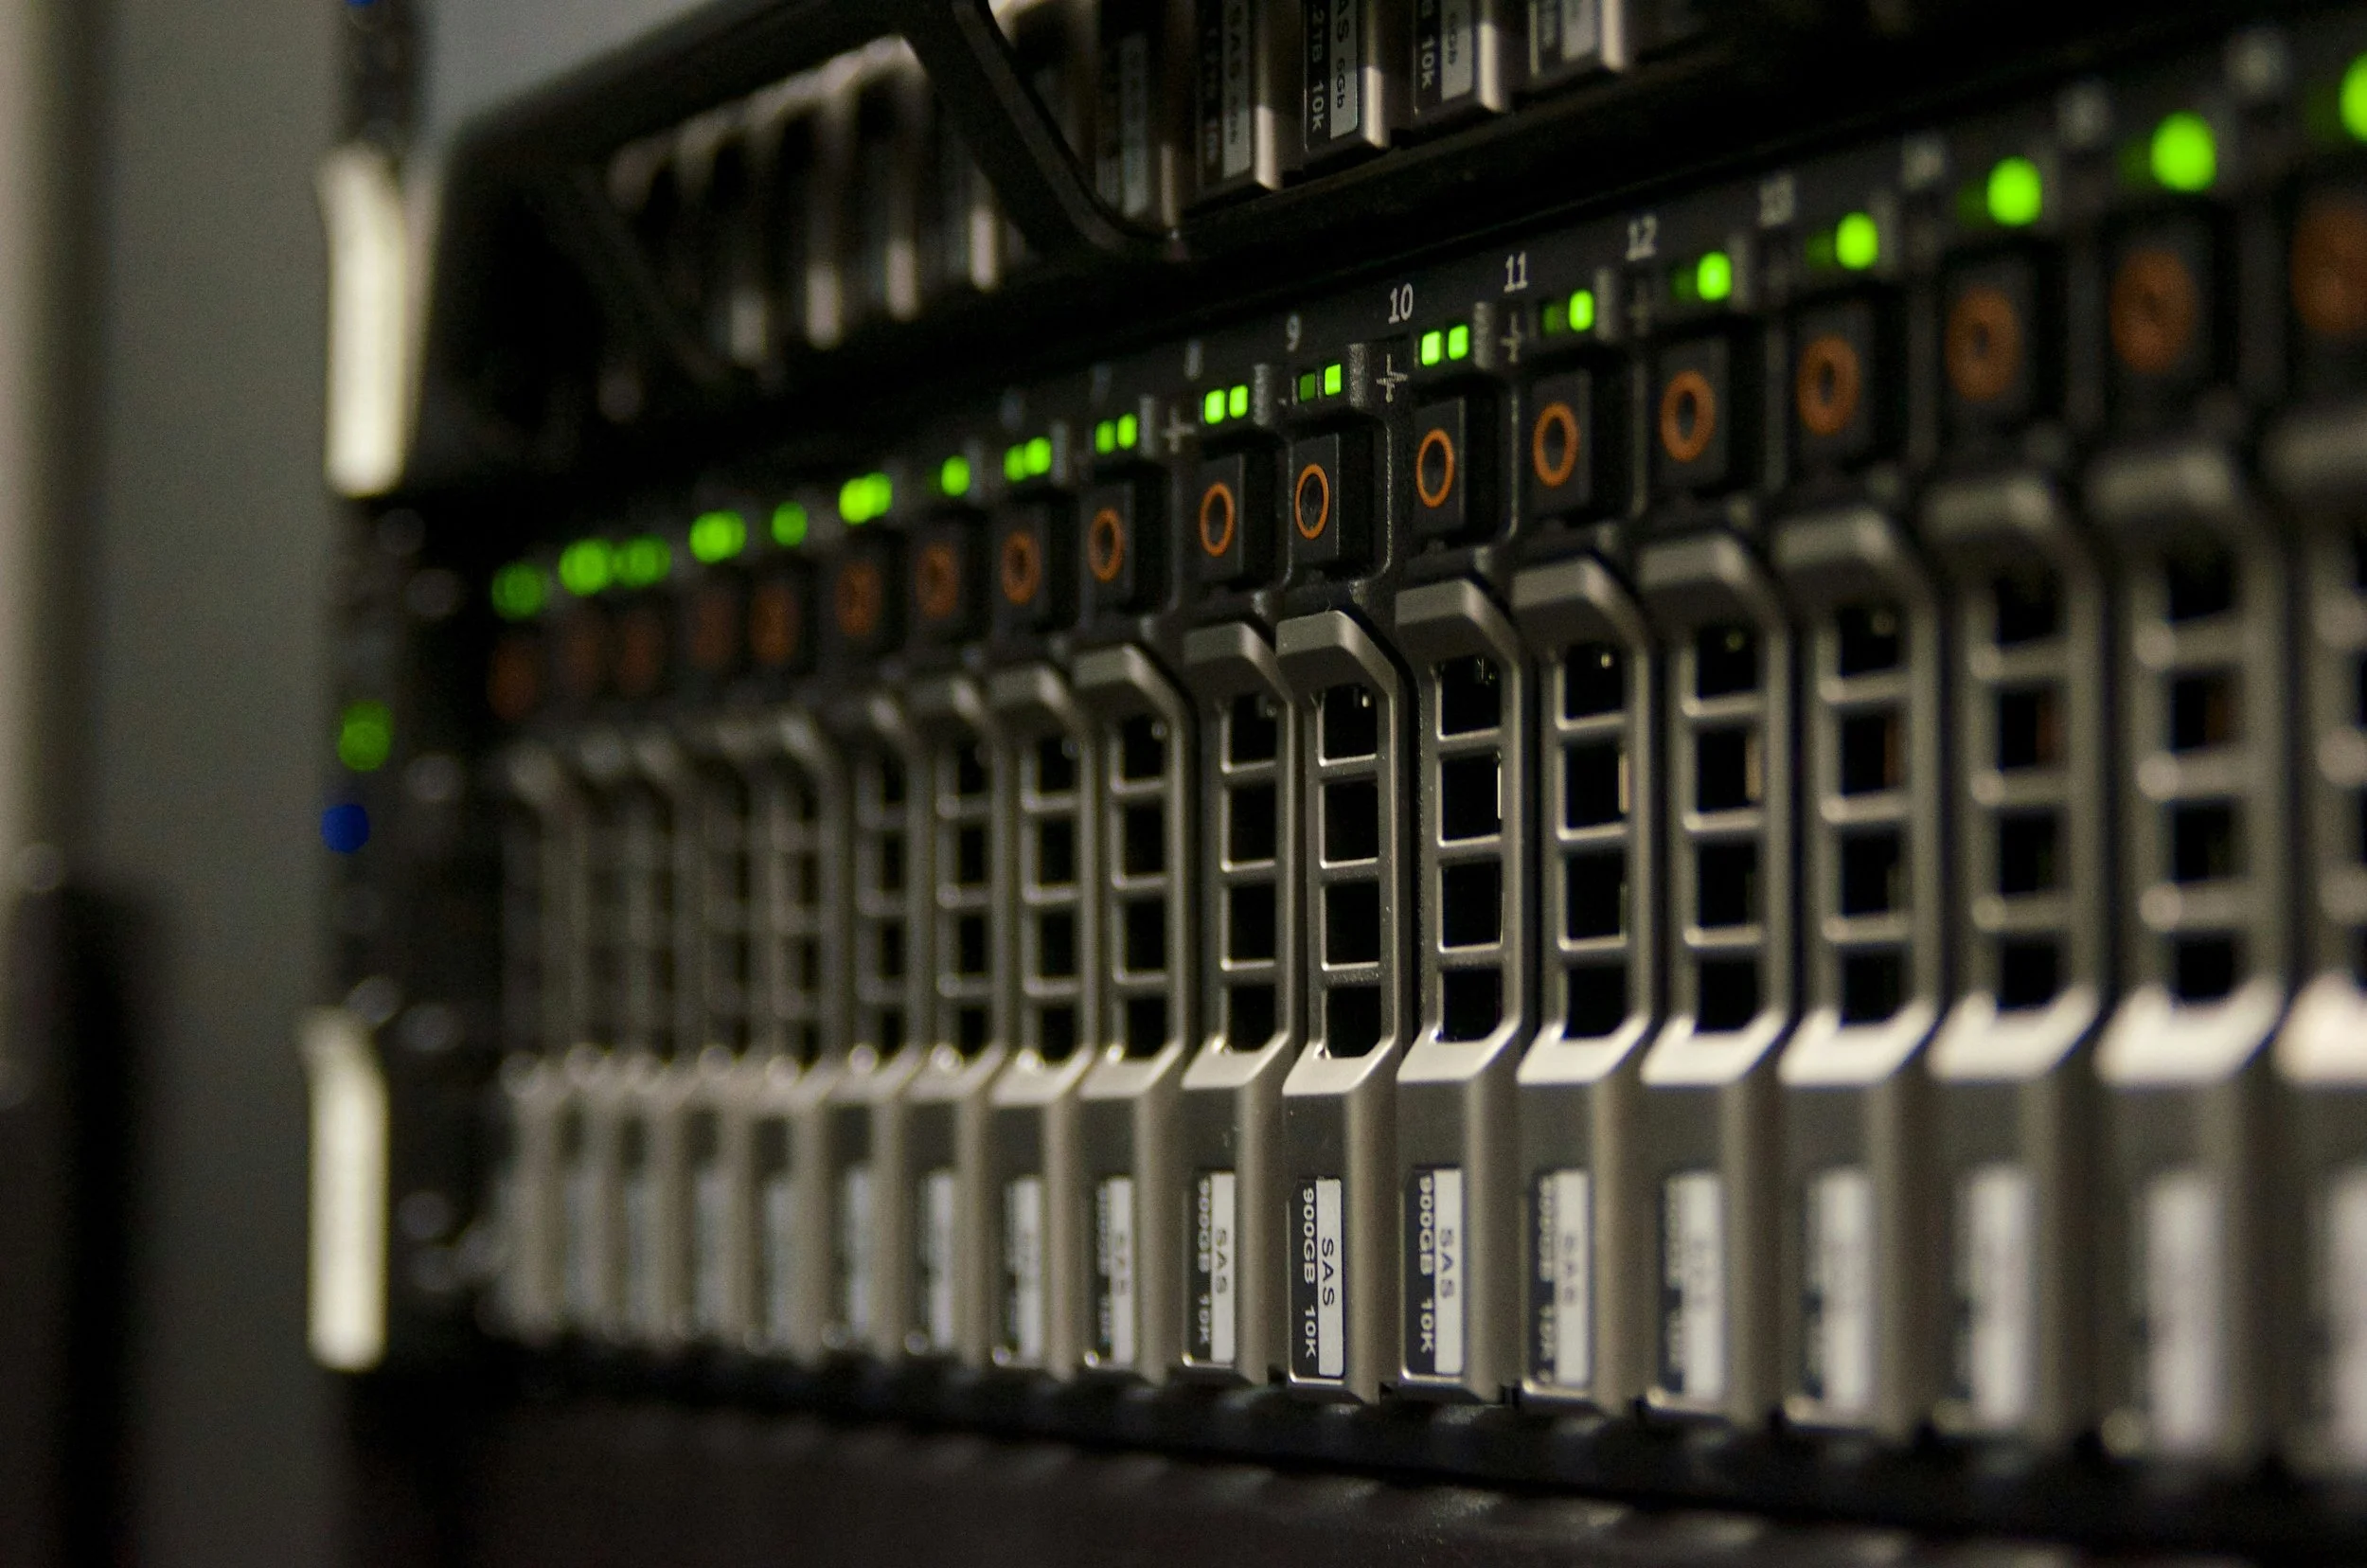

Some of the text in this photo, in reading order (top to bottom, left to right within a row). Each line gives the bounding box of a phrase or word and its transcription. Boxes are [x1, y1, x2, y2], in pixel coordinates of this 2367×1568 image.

[1626, 216, 1657, 261] 12
[1388, 283, 1414, 324] 10
[1504, 251, 1528, 293] 11
[1286, 313, 1301, 351] 9
[1419, 1176, 1433, 1276] 900GB
[1216, 1228, 1227, 1293] SAS
[1303, 1187, 1317, 1359] 900GB 10K
[1322, 1237, 1334, 1307] SAS
[1440, 1228, 1454, 1298] SAS
